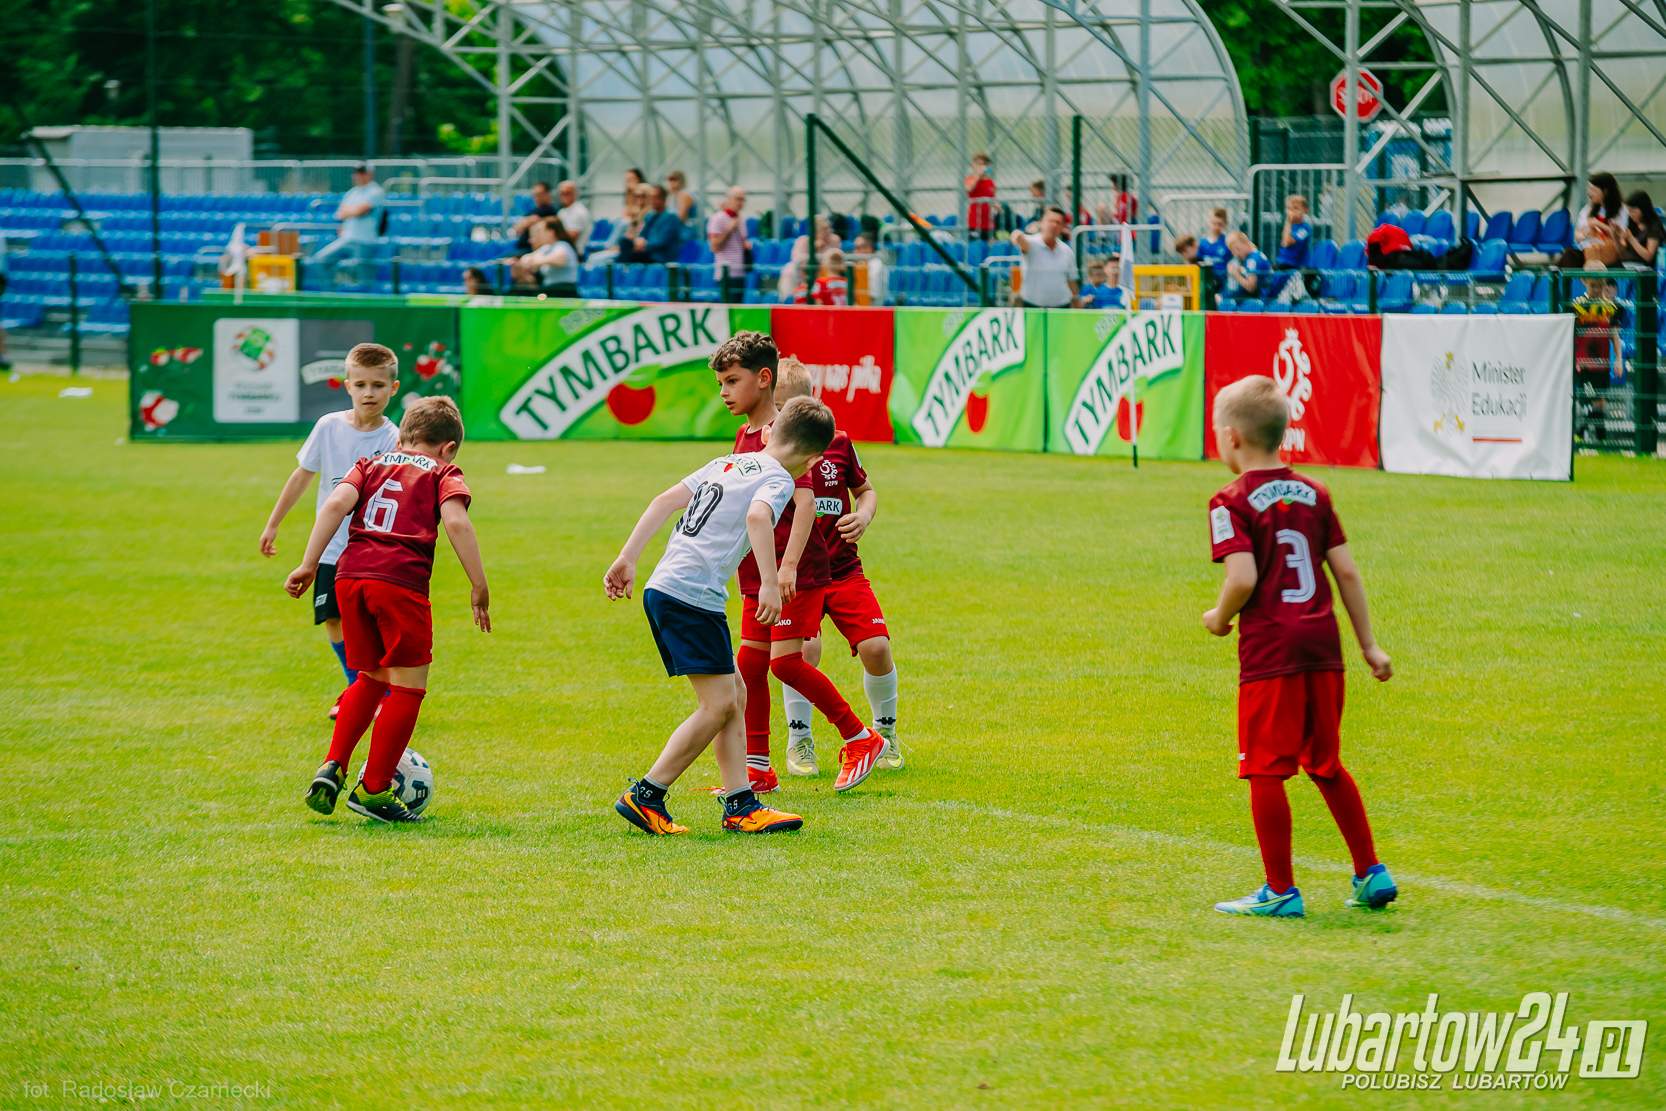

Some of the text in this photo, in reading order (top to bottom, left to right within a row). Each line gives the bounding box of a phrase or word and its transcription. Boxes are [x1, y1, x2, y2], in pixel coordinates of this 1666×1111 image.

[515, 309, 718, 427] TYMBARK
[925, 311, 1019, 438] TYMBARK
[1073, 314, 1176, 445] TYMBARK
[1472, 360, 1527, 384] Minister
[1472, 392, 1527, 422] Edukacji
[363, 479, 403, 533] 6
[1275, 529, 1316, 603] 3
